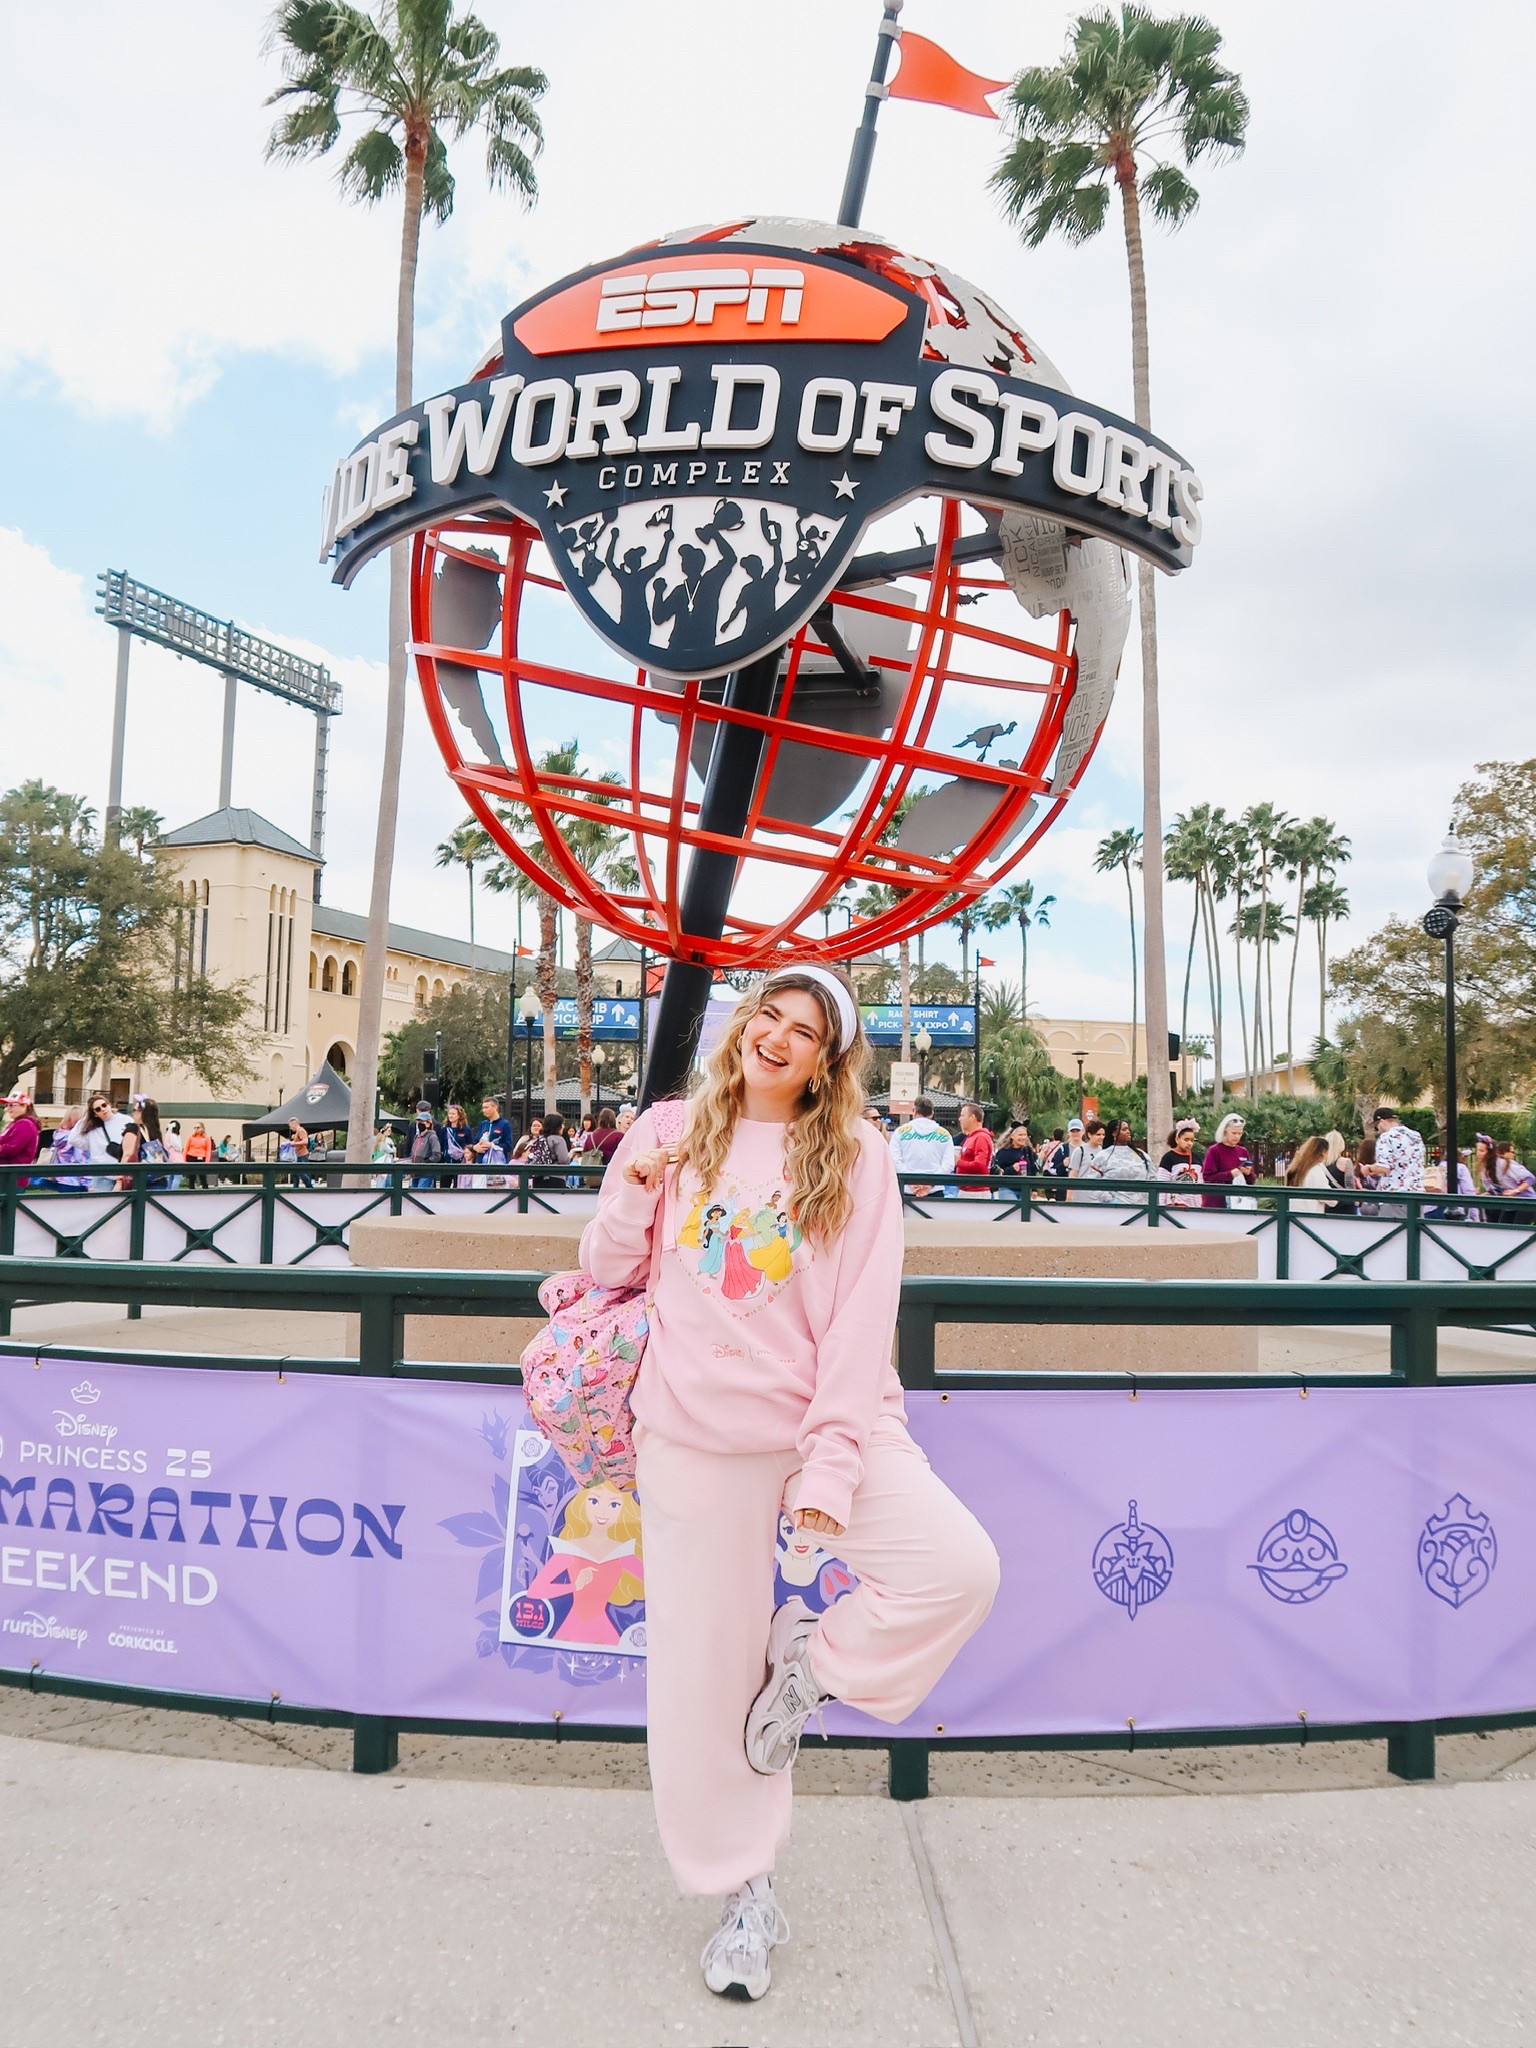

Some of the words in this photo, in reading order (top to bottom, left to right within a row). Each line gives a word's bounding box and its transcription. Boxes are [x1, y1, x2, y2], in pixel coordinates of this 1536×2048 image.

[595, 268, 804, 333] ESPN
[319, 420, 419, 564] WIDE
[423, 364, 781, 486] WORLD
[797, 377, 917, 456] OF
[924, 368, 1204, 547] SPORTS
[598, 461, 791, 490] COMPLEX
[655, 507, 670, 521] W
[878, 1021, 914, 1029] PICK-P
[925, 1021, 949, 1029] EXPO
[888, 1010, 911, 1018] RAC
[913, 1010, 939, 1018] SHIRT
[51, 1410, 118, 1445] Disney
[19, 1440, 148, 1474] PRINCESS
[165, 1448, 212, 1479] 25
[0, 1474, 406, 1559] MARATHON
[2, 1546, 218, 1606] EEKEND
